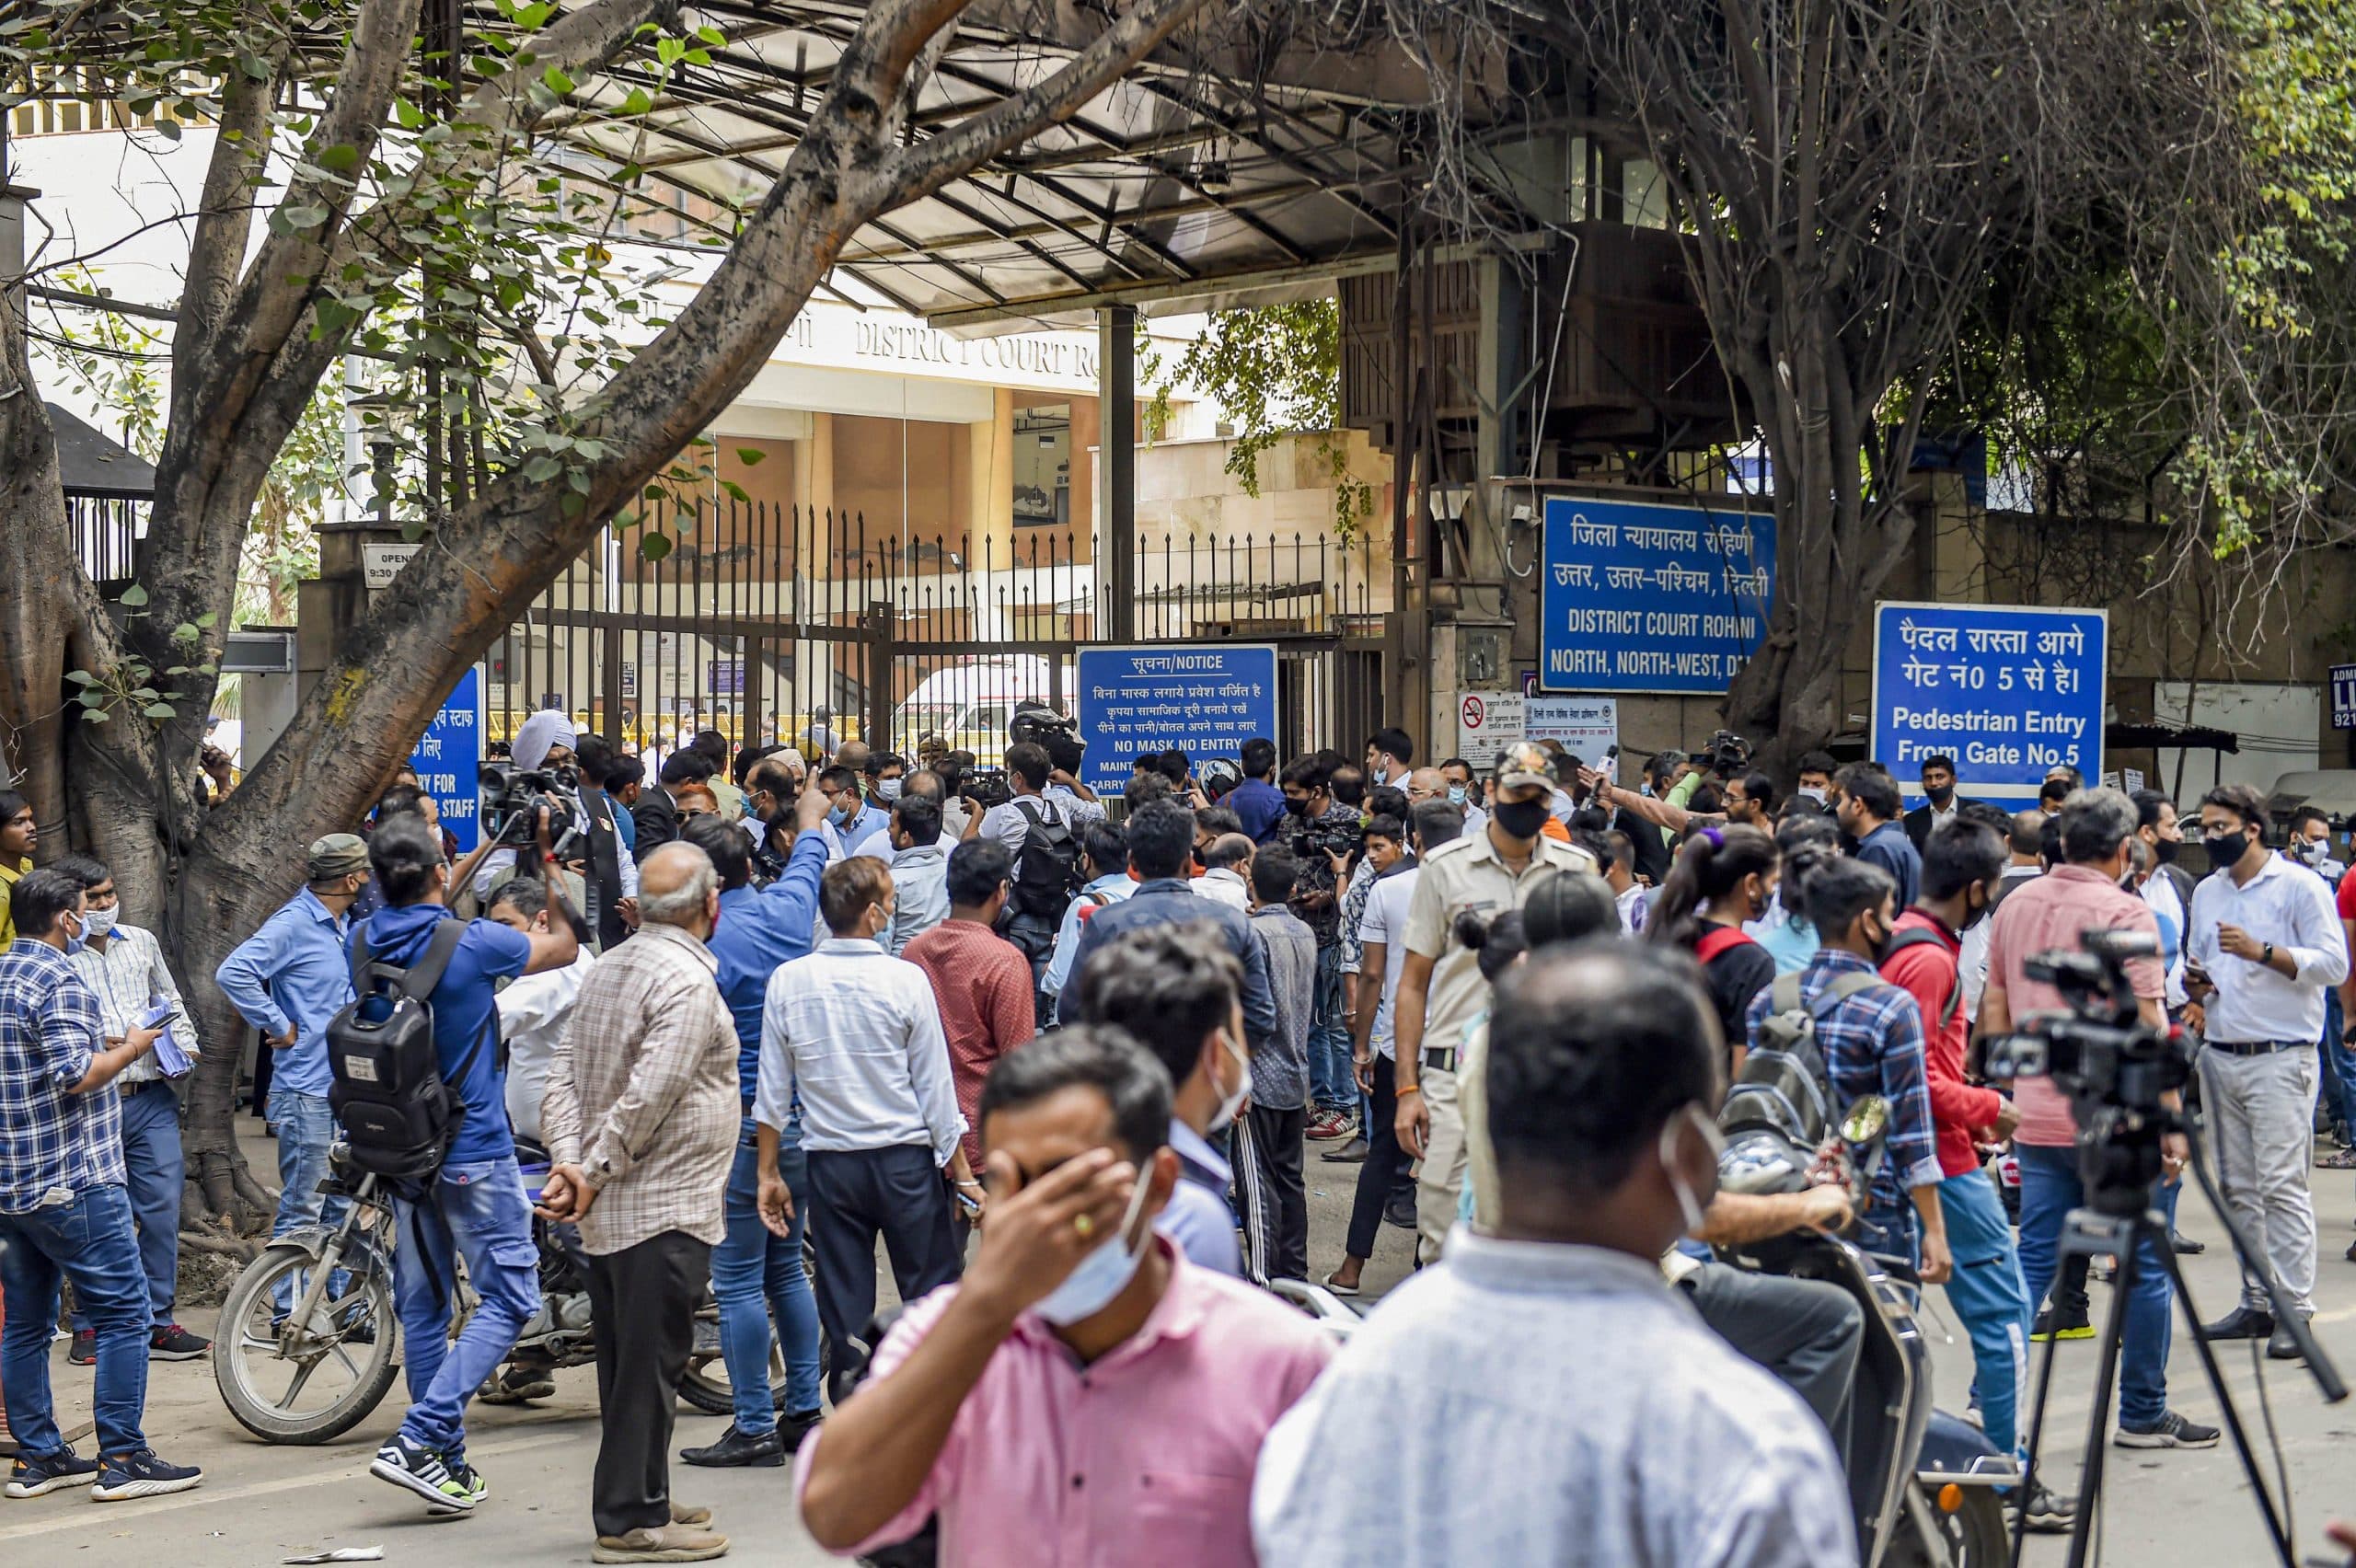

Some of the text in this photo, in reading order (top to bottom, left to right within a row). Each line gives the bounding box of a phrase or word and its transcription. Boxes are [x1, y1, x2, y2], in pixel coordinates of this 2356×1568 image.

[981, 339, 1066, 374] COURT
[1570, 513, 1617, 547] जिला
[1623, 526, 1697, 552] न्यायालय
[381, 554, 412, 563] OPEN
[369, 569, 392, 578] 9:30
[1553, 563, 1599, 590] उत्तर,
[1569, 609, 1754, 639] DISTRICT COURT ROHINI
[1900, 617, 2084, 655] पैदल रास्ता आगे
[1552, 649, 1611, 676] NORTH,
[1617, 651, 1721, 679] NORTH-WEST,
[1901, 654, 1940, 686] गेट
[1998, 667, 2013, 690] 5
[2022, 659, 2045, 691] से
[2333, 671, 2356, 681] ADM
[1092, 683, 1261, 699] बिना मास्क लगाये प्रवेश वर्जित है
[449, 710, 473, 727] स्टाफ
[1106, 708, 1133, 720] कृपया
[1184, 703, 1200, 718] दूरी
[1203, 702, 1228, 714] बनाये
[1097, 721, 1114, 733] पीने
[1118, 724, 1131, 732] का
[1188, 720, 1210, 731] अपने
[1214, 722, 1234, 731] साथ
[1893, 707, 2085, 739] Pedestrian Entry
[1115, 738, 1242, 752] NO MASK NO ENTRY
[1898, 740, 2079, 766] From Gate No.5
[1100, 760, 1135, 772] MAINT
[434, 774, 456, 792] FOR
[1090, 778, 1126, 790] CARRY
[443, 799, 474, 817] STAFF
